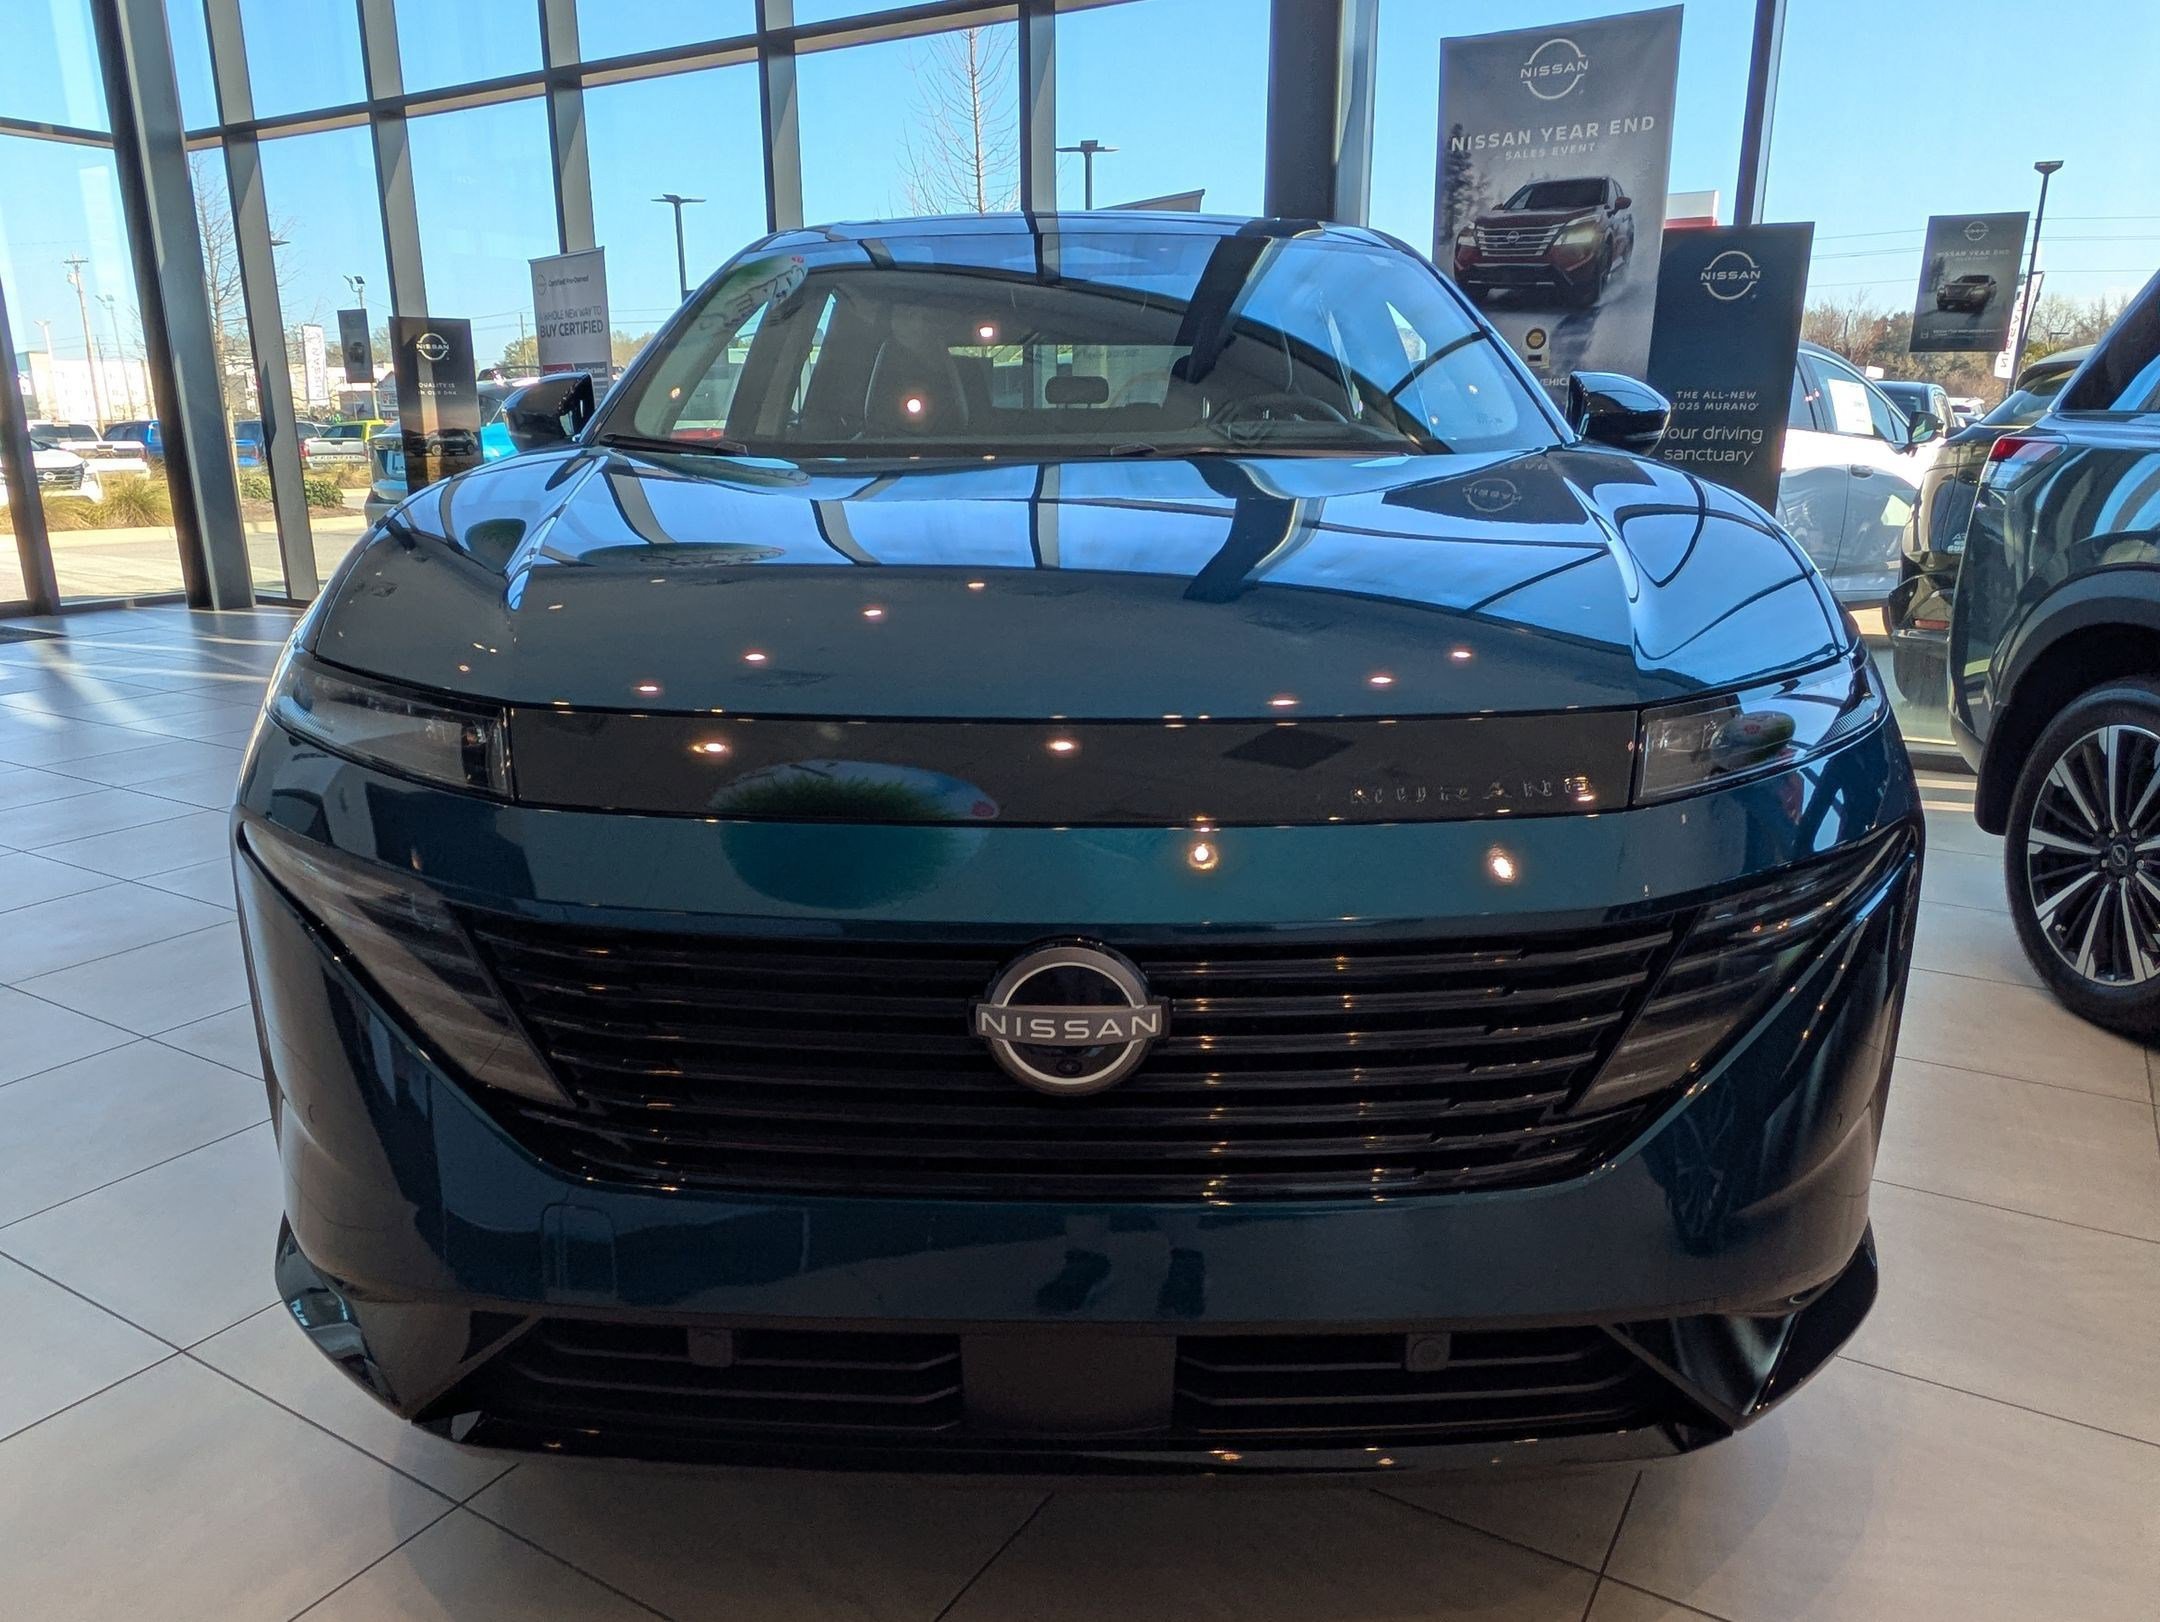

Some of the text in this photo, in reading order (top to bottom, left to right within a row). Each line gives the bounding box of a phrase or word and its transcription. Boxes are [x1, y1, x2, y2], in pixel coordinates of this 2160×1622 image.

[1520, 60, 1589, 79] NISSAN
[1451, 116, 1655, 151] NISSAN YEAR END
[1505, 143, 1596, 161] SALES EVENT
[1700, 270, 1761, 281] NISSAN
[540, 320, 604, 338] BUY CERTIFIED
[1676, 391, 1757, 399] THE ALL-NEW
[1671, 402, 1758, 411] 2025 MURANO
[1703, 425, 1763, 444] driving
[1663, 448, 1754, 465] sanctuary
[980, 1012, 1157, 1039] NISSAN
